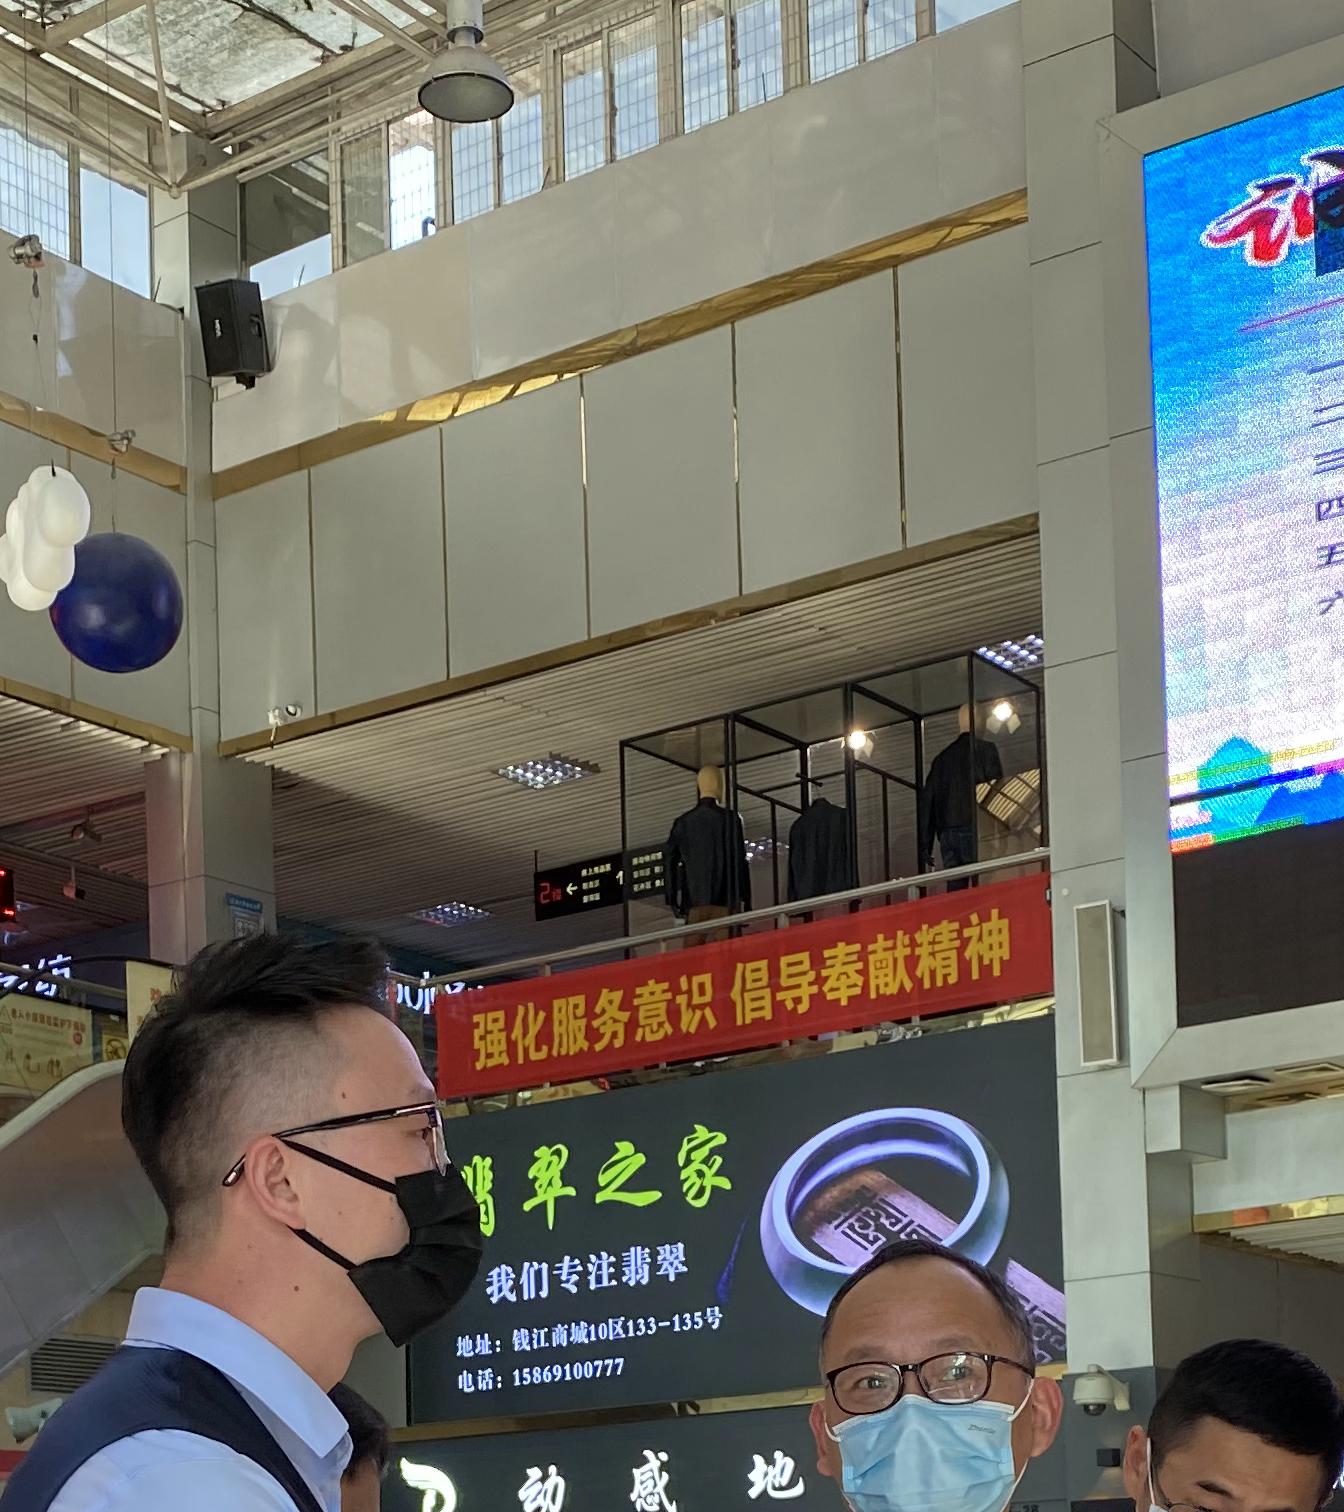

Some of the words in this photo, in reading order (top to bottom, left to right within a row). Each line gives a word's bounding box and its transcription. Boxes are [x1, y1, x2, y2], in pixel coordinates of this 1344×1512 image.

[473, 972, 718, 1071] 强化服务意识
[730, 907, 1011, 1026] 倡导奉献精神
[485, 1241, 690, 1305] 我们专注翡翠
